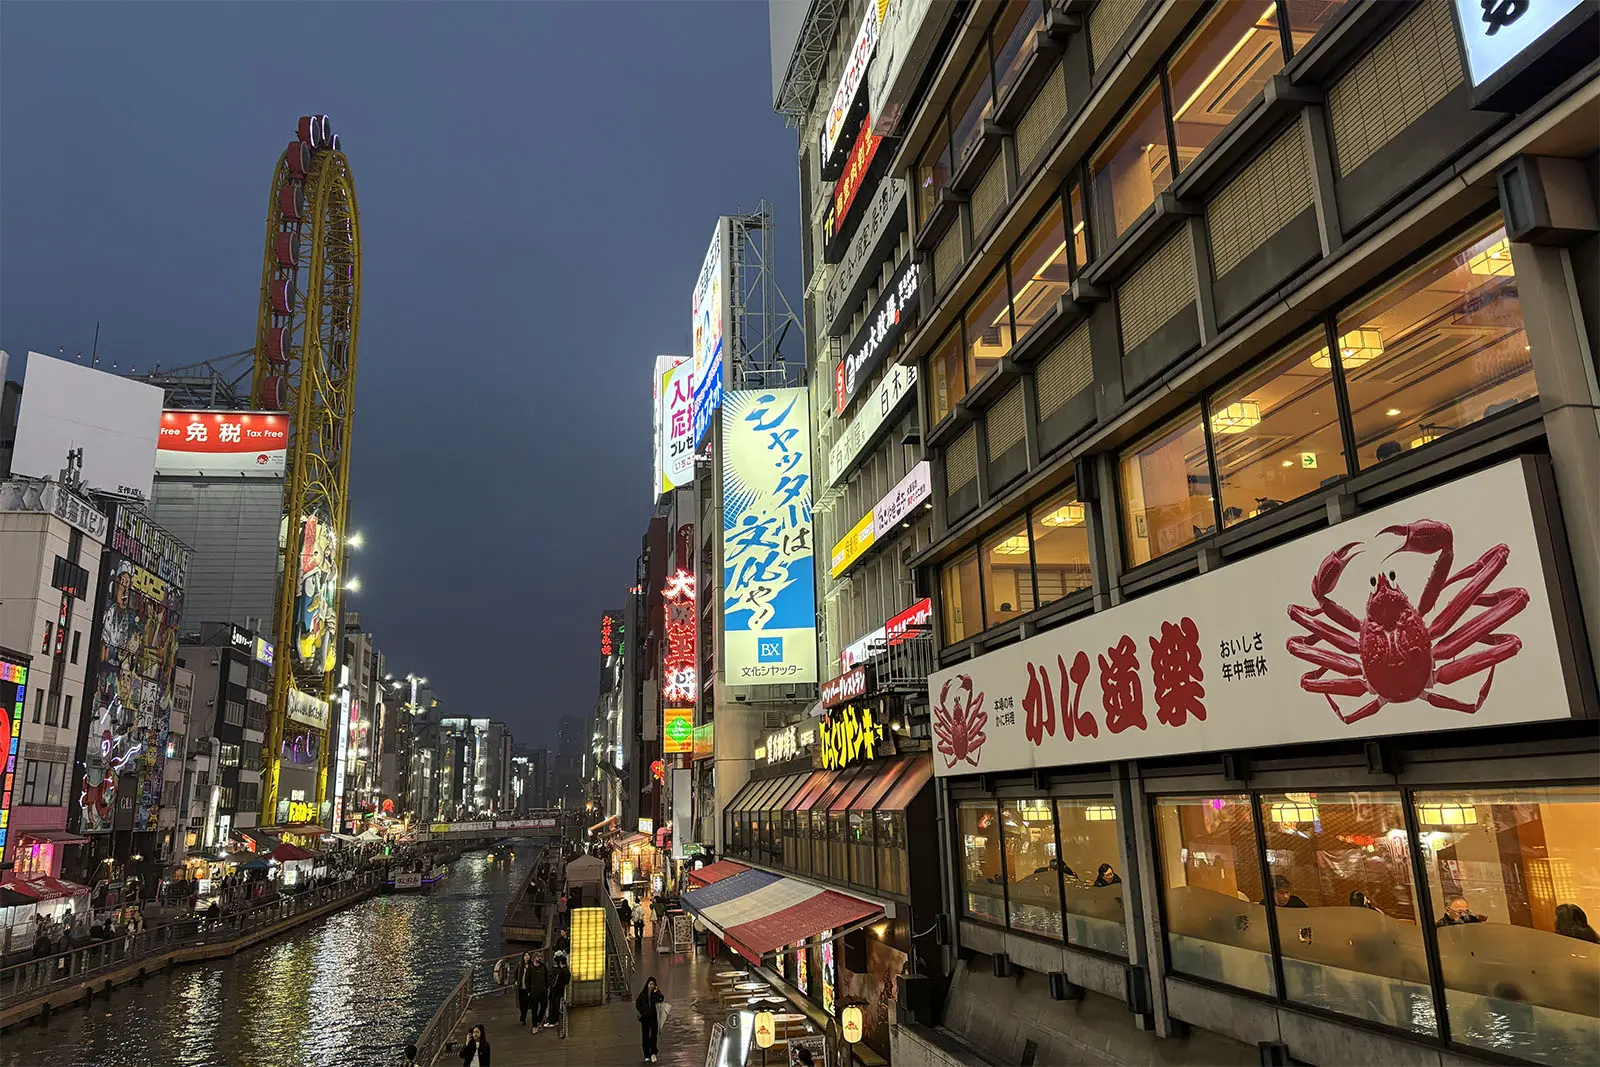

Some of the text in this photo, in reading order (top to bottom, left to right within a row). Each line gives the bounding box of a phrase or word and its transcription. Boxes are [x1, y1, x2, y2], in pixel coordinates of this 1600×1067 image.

[824, 207, 835, 247] 7F
[836, 369, 845, 410] 5F
[160, 421, 284, 443] Free 免税 Tax Free
[132, 566, 167, 602] 2025
[760, 642, 782, 657] BX
[1219, 631, 1263, 659] おいしさ
[1221, 655, 1268, 682] 年中無休
